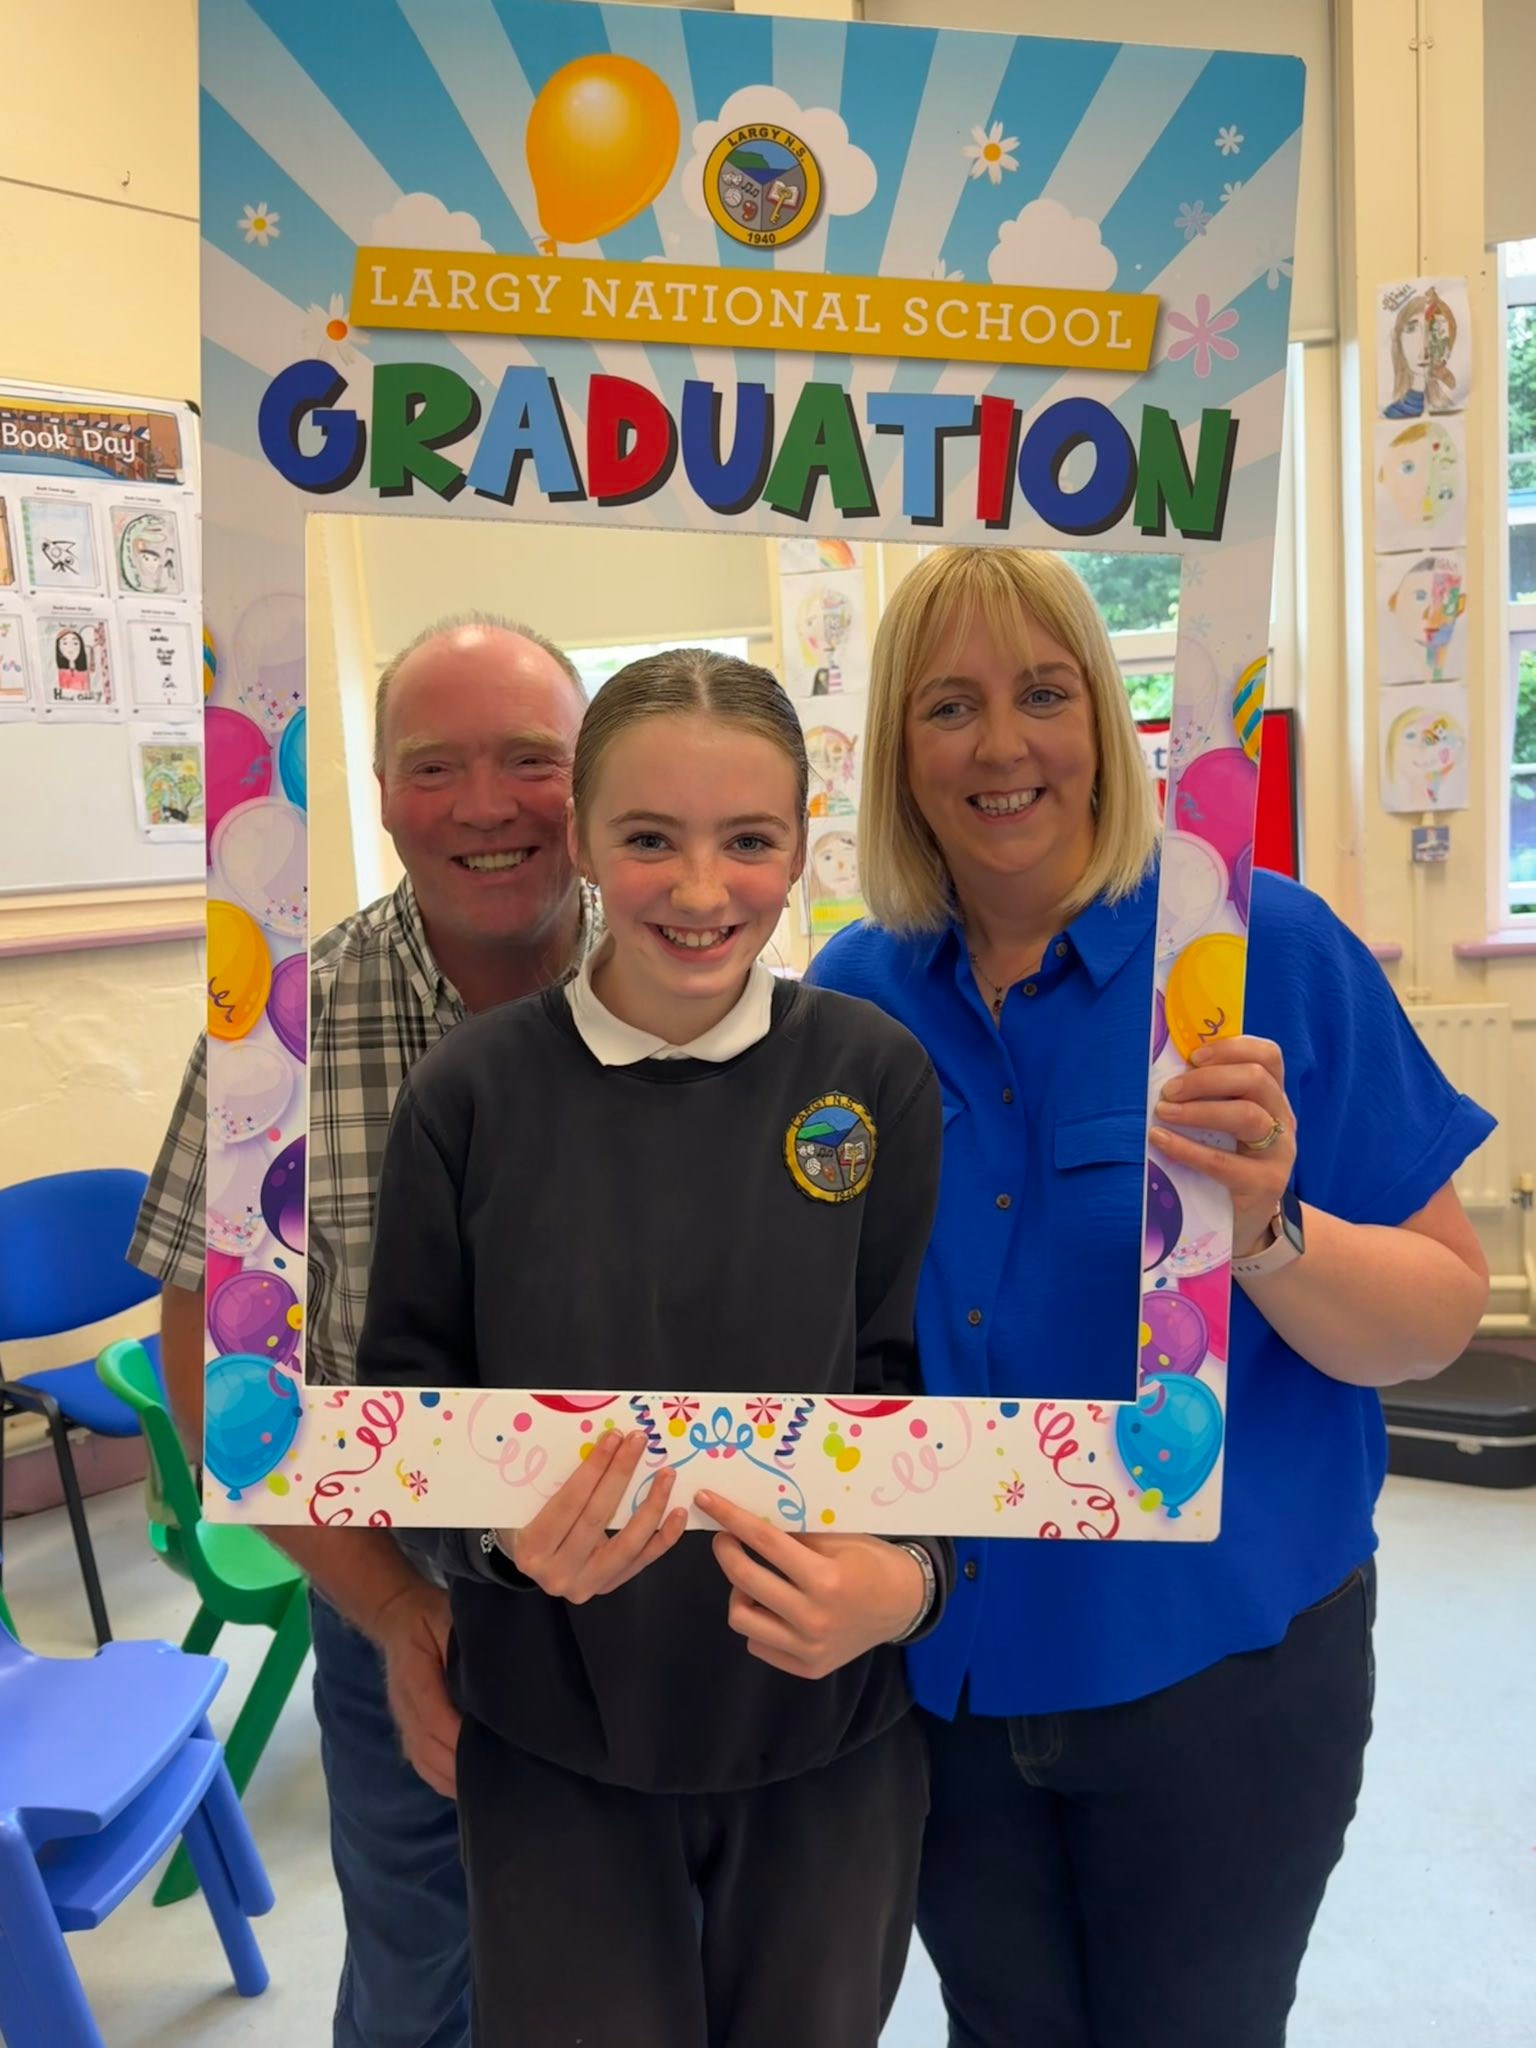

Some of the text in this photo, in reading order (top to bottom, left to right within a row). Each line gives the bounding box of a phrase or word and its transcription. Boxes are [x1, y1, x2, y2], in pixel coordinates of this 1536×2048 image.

[726, 127, 806, 163] LARGY N.S.
[747, 233, 777, 245] 1940
[370, 264, 1133, 350] LARGY NATIONAL SCHOOL
[1, 421, 136, 463] Book Day
[257, 359, 1238, 540] GRADUATION
